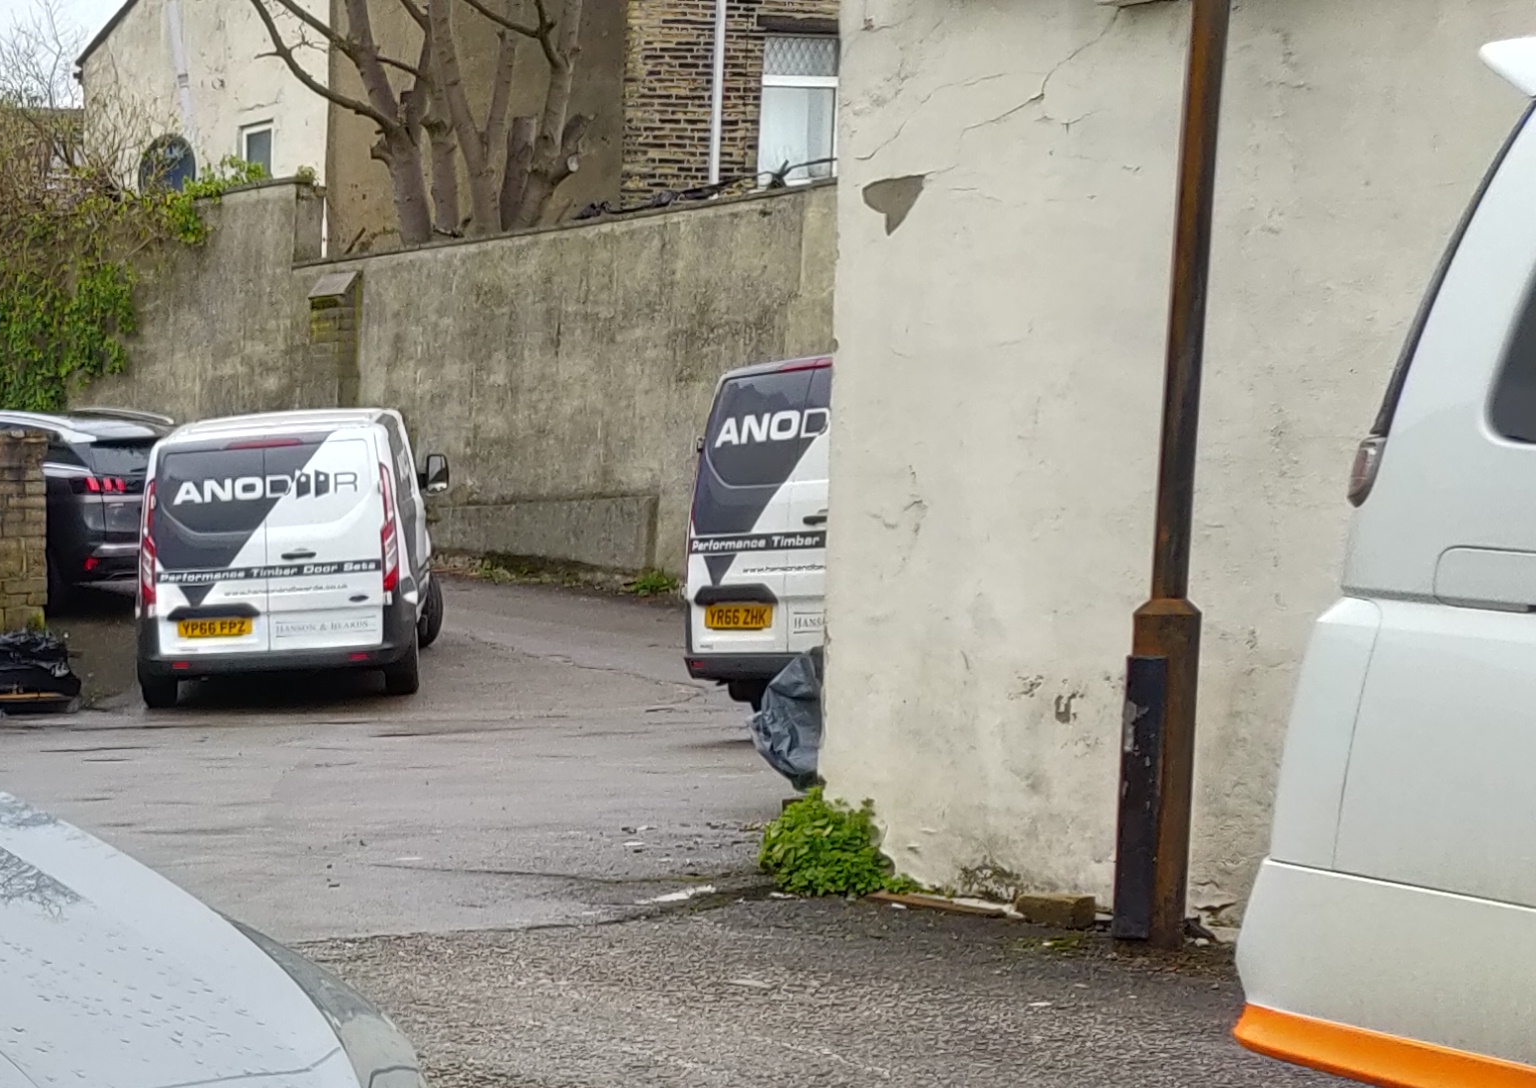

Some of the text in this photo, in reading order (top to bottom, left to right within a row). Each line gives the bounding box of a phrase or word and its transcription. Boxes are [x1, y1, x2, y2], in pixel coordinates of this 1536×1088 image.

[691, 533, 820, 551] Performance Timber
[159, 561, 376, 583] Performance Timber Door Sets
[709, 607, 768, 626] YR66 ZHK
[181, 619, 247, 636] YP66 FPZ
